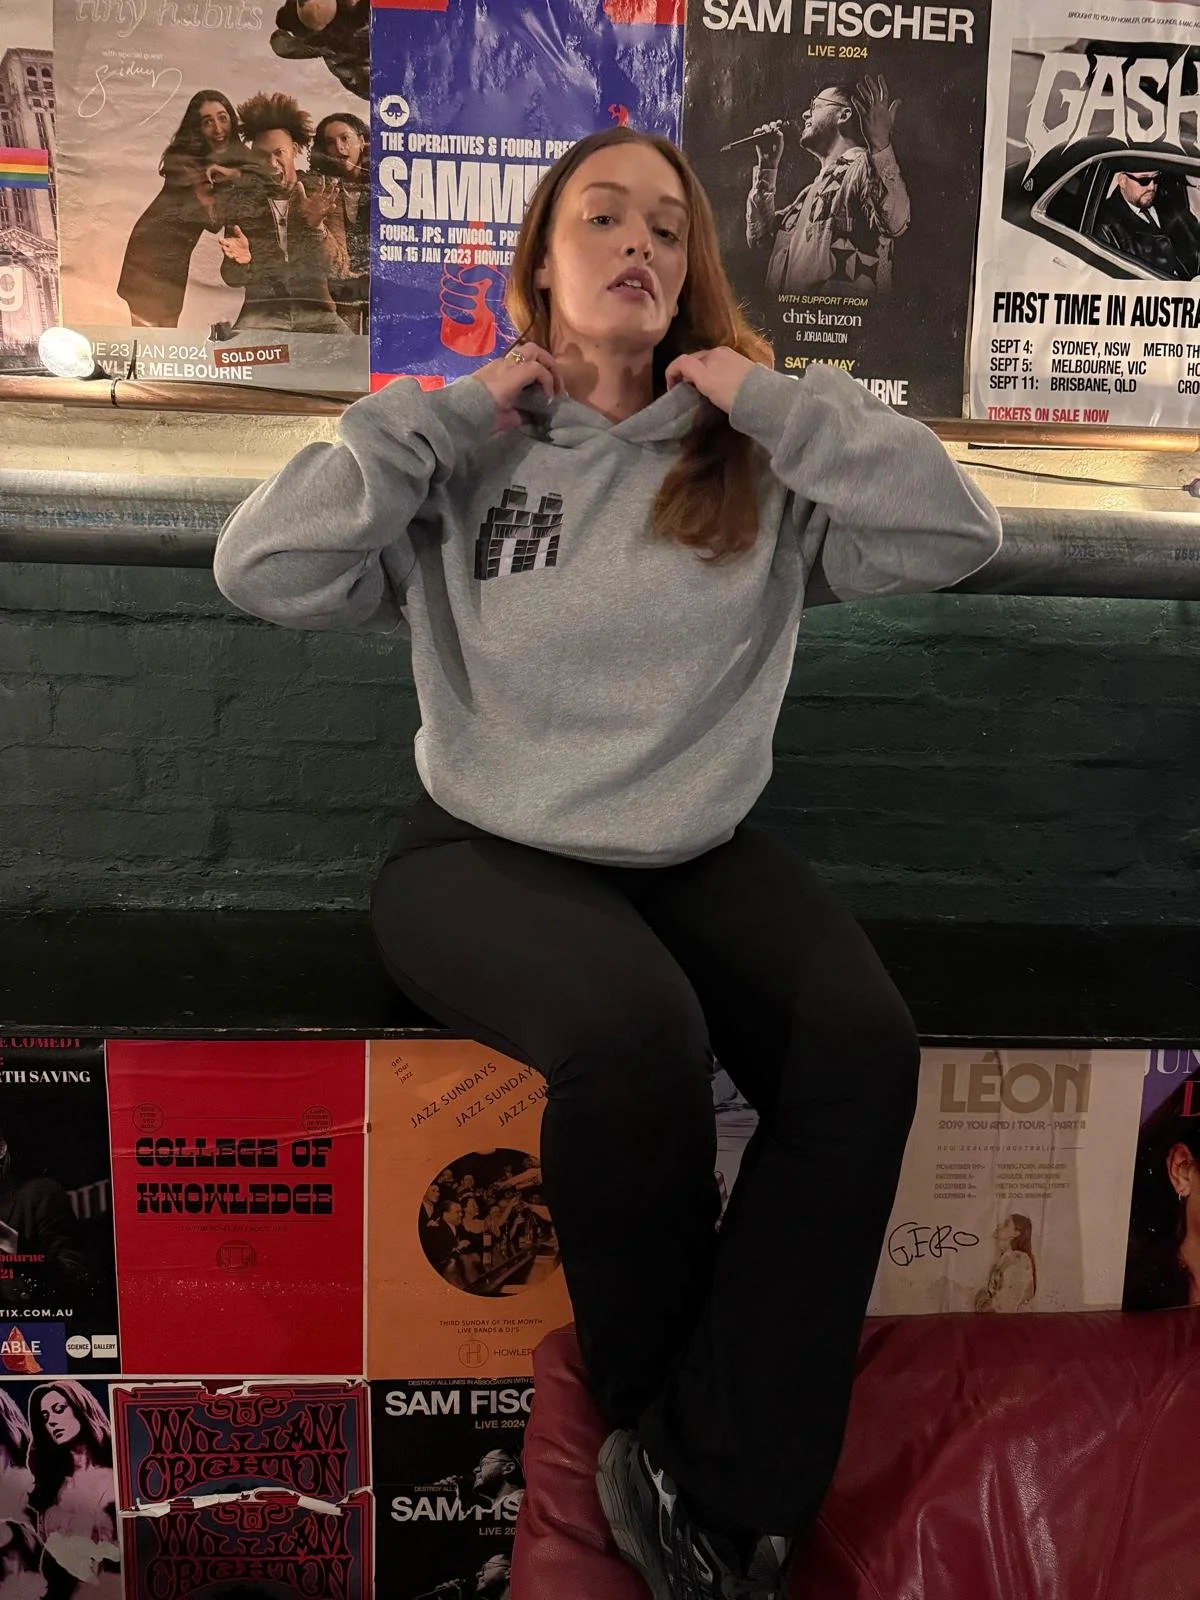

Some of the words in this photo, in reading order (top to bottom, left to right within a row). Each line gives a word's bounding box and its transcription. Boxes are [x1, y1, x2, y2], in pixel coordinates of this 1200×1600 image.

[157, 0, 264, 29] habits
[703, 0, 792, 34] SAM
[803, 0, 975, 44] FISCHER
[807, 45, 836, 57] LIVE
[838, 46, 868, 58] 2024
[380, 132, 404, 152] THE
[408, 133, 484, 155] OPERATIVES
[488, 136, 497, 156] &
[500, 138, 542, 158] FOURA
[379, 224, 418, 242] FOURA.
[422, 226, 444, 244] JPS.
[380, 246, 402, 262] SUN
[406, 246, 418, 262] 15
[422, 248, 440, 263] JAN
[444, 248, 472, 264] 2023
[778, 294, 800, 303] WITH
[801, 295, 842, 305] SUPPORT
[843, 298, 868, 306] FROM
[782, 308, 816, 324] chris
[818, 310, 862, 327] lanzon
[992, 292, 1049, 324] FIRST
[1054, 293, 1102, 326] TIME
[1106, 295, 1126, 326] IN
[796, 330, 801, 342] &
[822, 332, 848, 344] DALTON
[110, 344, 130, 357] 23
[135, 344, 165, 358] JAN
[169, 346, 208, 360] 2024
[990, 339, 1020, 354] SEPT
[1022, 340, 1033, 355] 4:
[1052, 340, 1100, 358] SYDNEY,
[1104, 342, 1131, 357] NSW
[1144, 342, 1184, 358] METRO
[221, 350, 254, 364] SOLD
[256, 348, 283, 361] OUT
[784, 356, 808, 369] SAT
[150, 362, 254, 380] MELBOURNE
[990, 358, 1020, 372] SEPT
[1022, 358, 1032, 372] 5:
[1052, 358, 1124, 377] MELBOURNE,
[1128, 360, 1147, 376] VIC
[990, 376, 1018, 390] SEPT
[1022, 376, 1039, 390] 11:
[1050, 377, 1111, 394] BRISBANE,
[1114, 379, 1136, 393] QLD
[988, 406, 1032, 422] TICKETS
[1034, 408, 1050, 422] ON
[1052, 408, 1080, 422] SALE
[1083, 409, 1110, 423] NOW
[391, 1056, 402, 1068] get
[394, 1062, 410, 1076] your
[0, 1070, 26, 1083] TH
[29, 1070, 91, 1083] SAVING
[410, 1101, 440, 1128] JAZZ
[440, 1062, 497, 1106] SUNDAYS
[455, 1101, 486, 1128] JAZZ
[498, 1100, 528, 1127] JAZZ
[938, 1120, 964, 1130] 2019
[966, 1120, 988, 1130] YOU
[990, 1120, 1010, 1130] AND
[1017, 1120, 1046, 1130] TOUR
[1054, 1120, 1078, 1130] PART
[136, 1136, 279, 1168] COLLEGE
[290, 1136, 333, 1168] OF
[136, 1182, 334, 1214] KNOWLEDGE
[0, 1308, 74, 1317] TIX.COM.AU
[0, 1340, 42, 1354] ABLE
[384, 1390, 460, 1416] SAM
[475, 1420, 499, 1430] LIVE
[501, 1420, 526, 1429] 2024
[390, 1496, 462, 1522] SAM
[478, 1527, 503, 1536] LIVE
